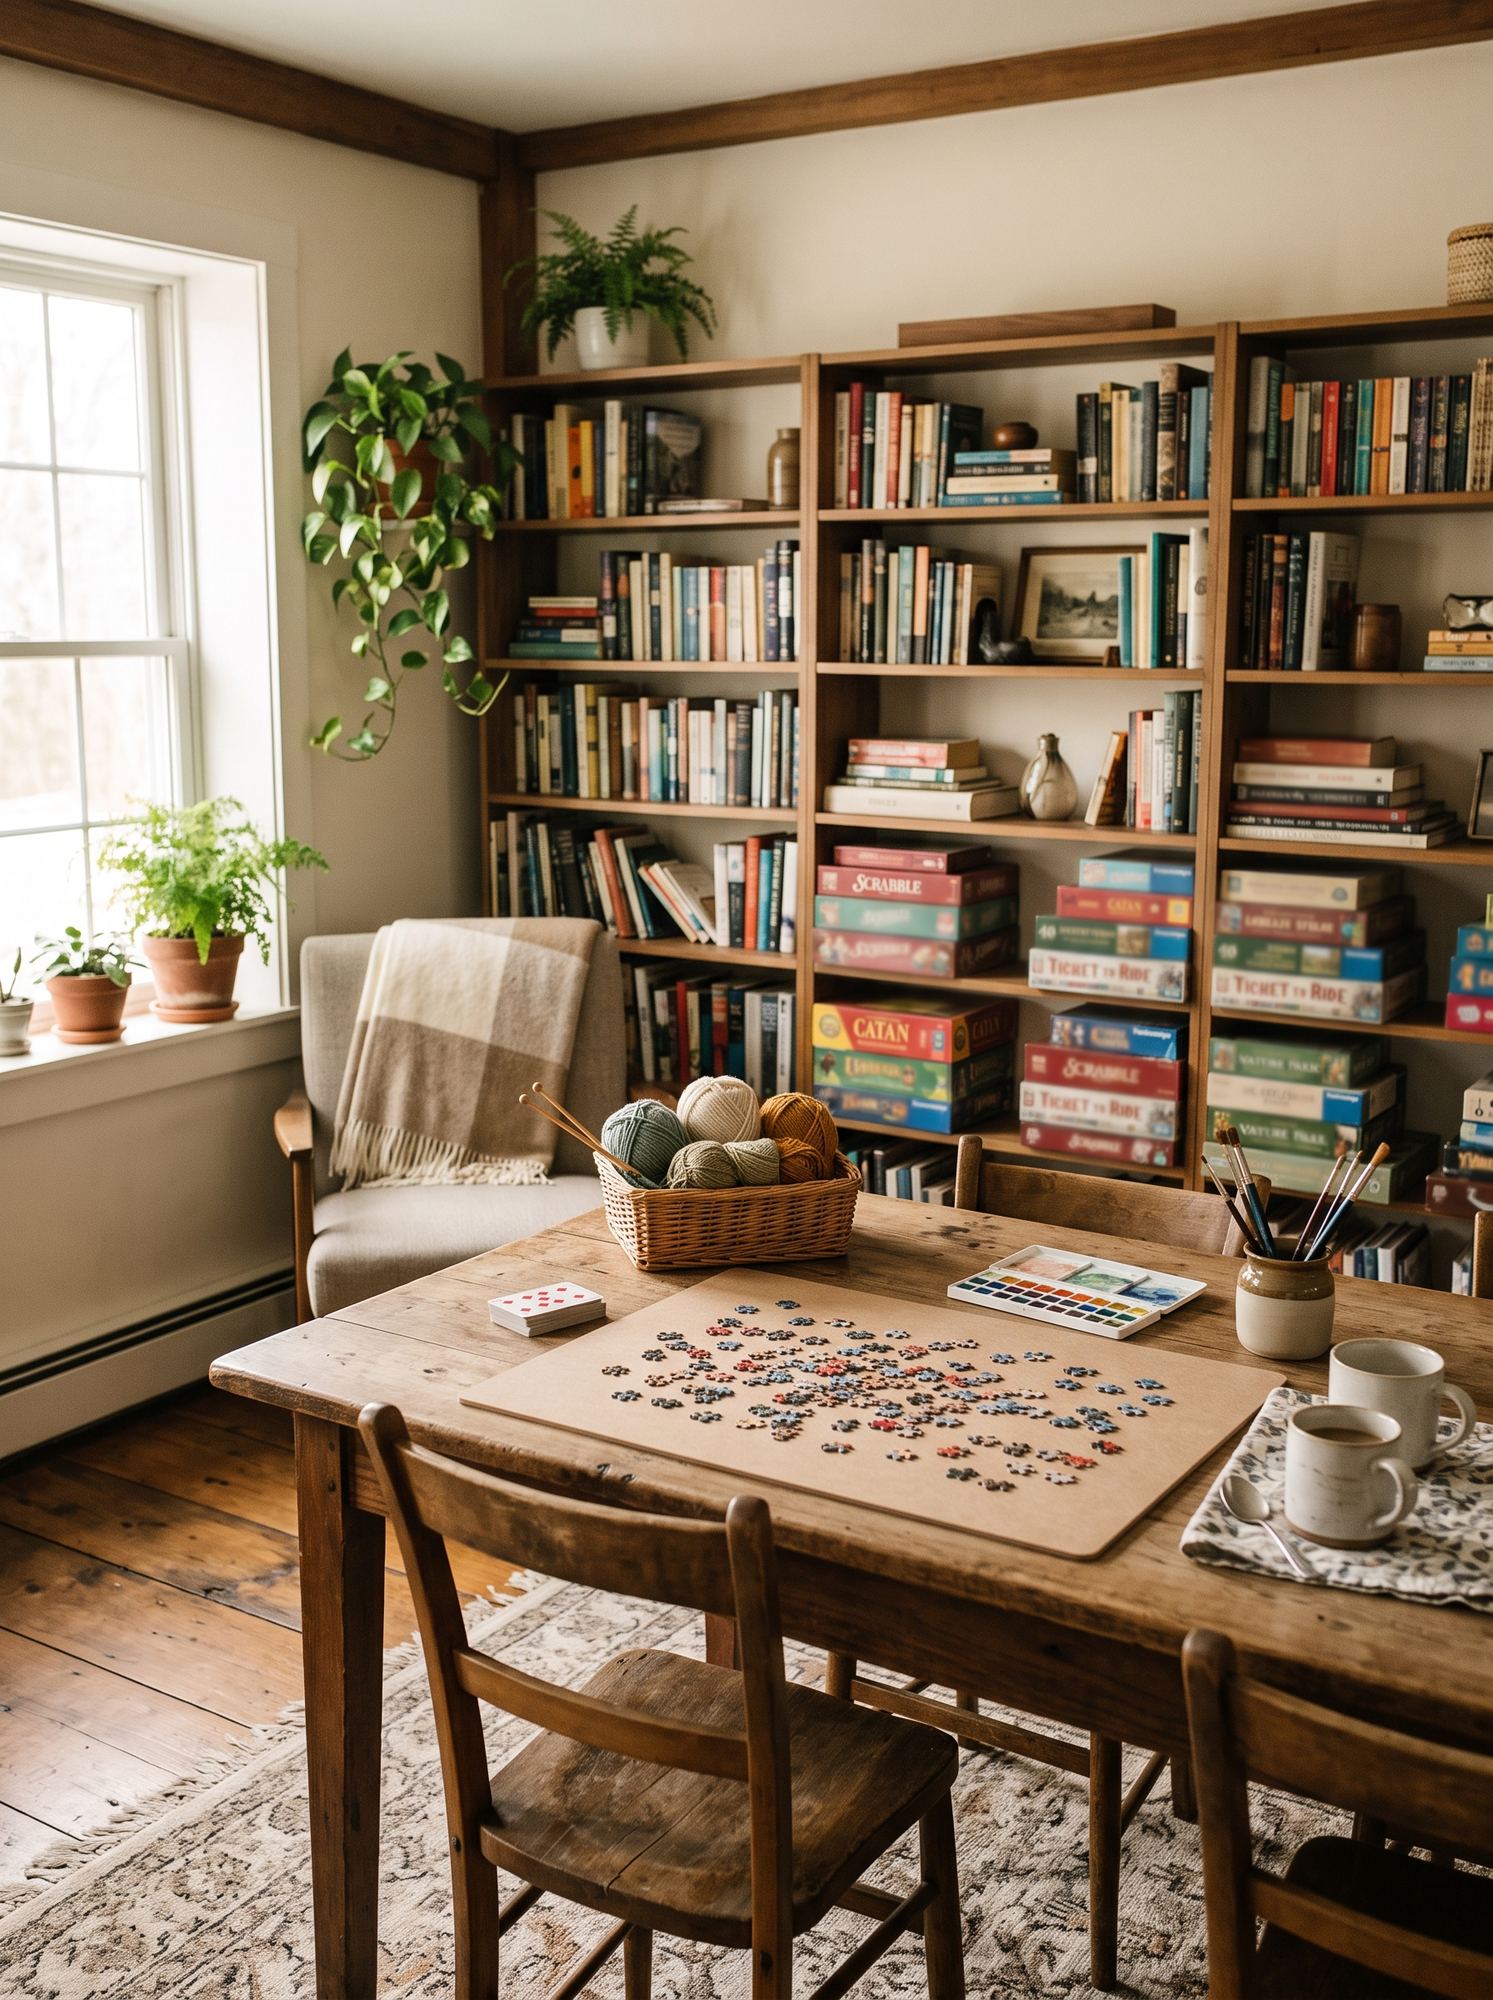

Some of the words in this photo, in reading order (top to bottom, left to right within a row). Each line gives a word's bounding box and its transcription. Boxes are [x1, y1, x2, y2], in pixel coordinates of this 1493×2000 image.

[852, 873, 922, 895] SCRABBLE
[1311, 982, 1347, 1004] RIDE
[853, 1018, 910, 1043] CATAN
